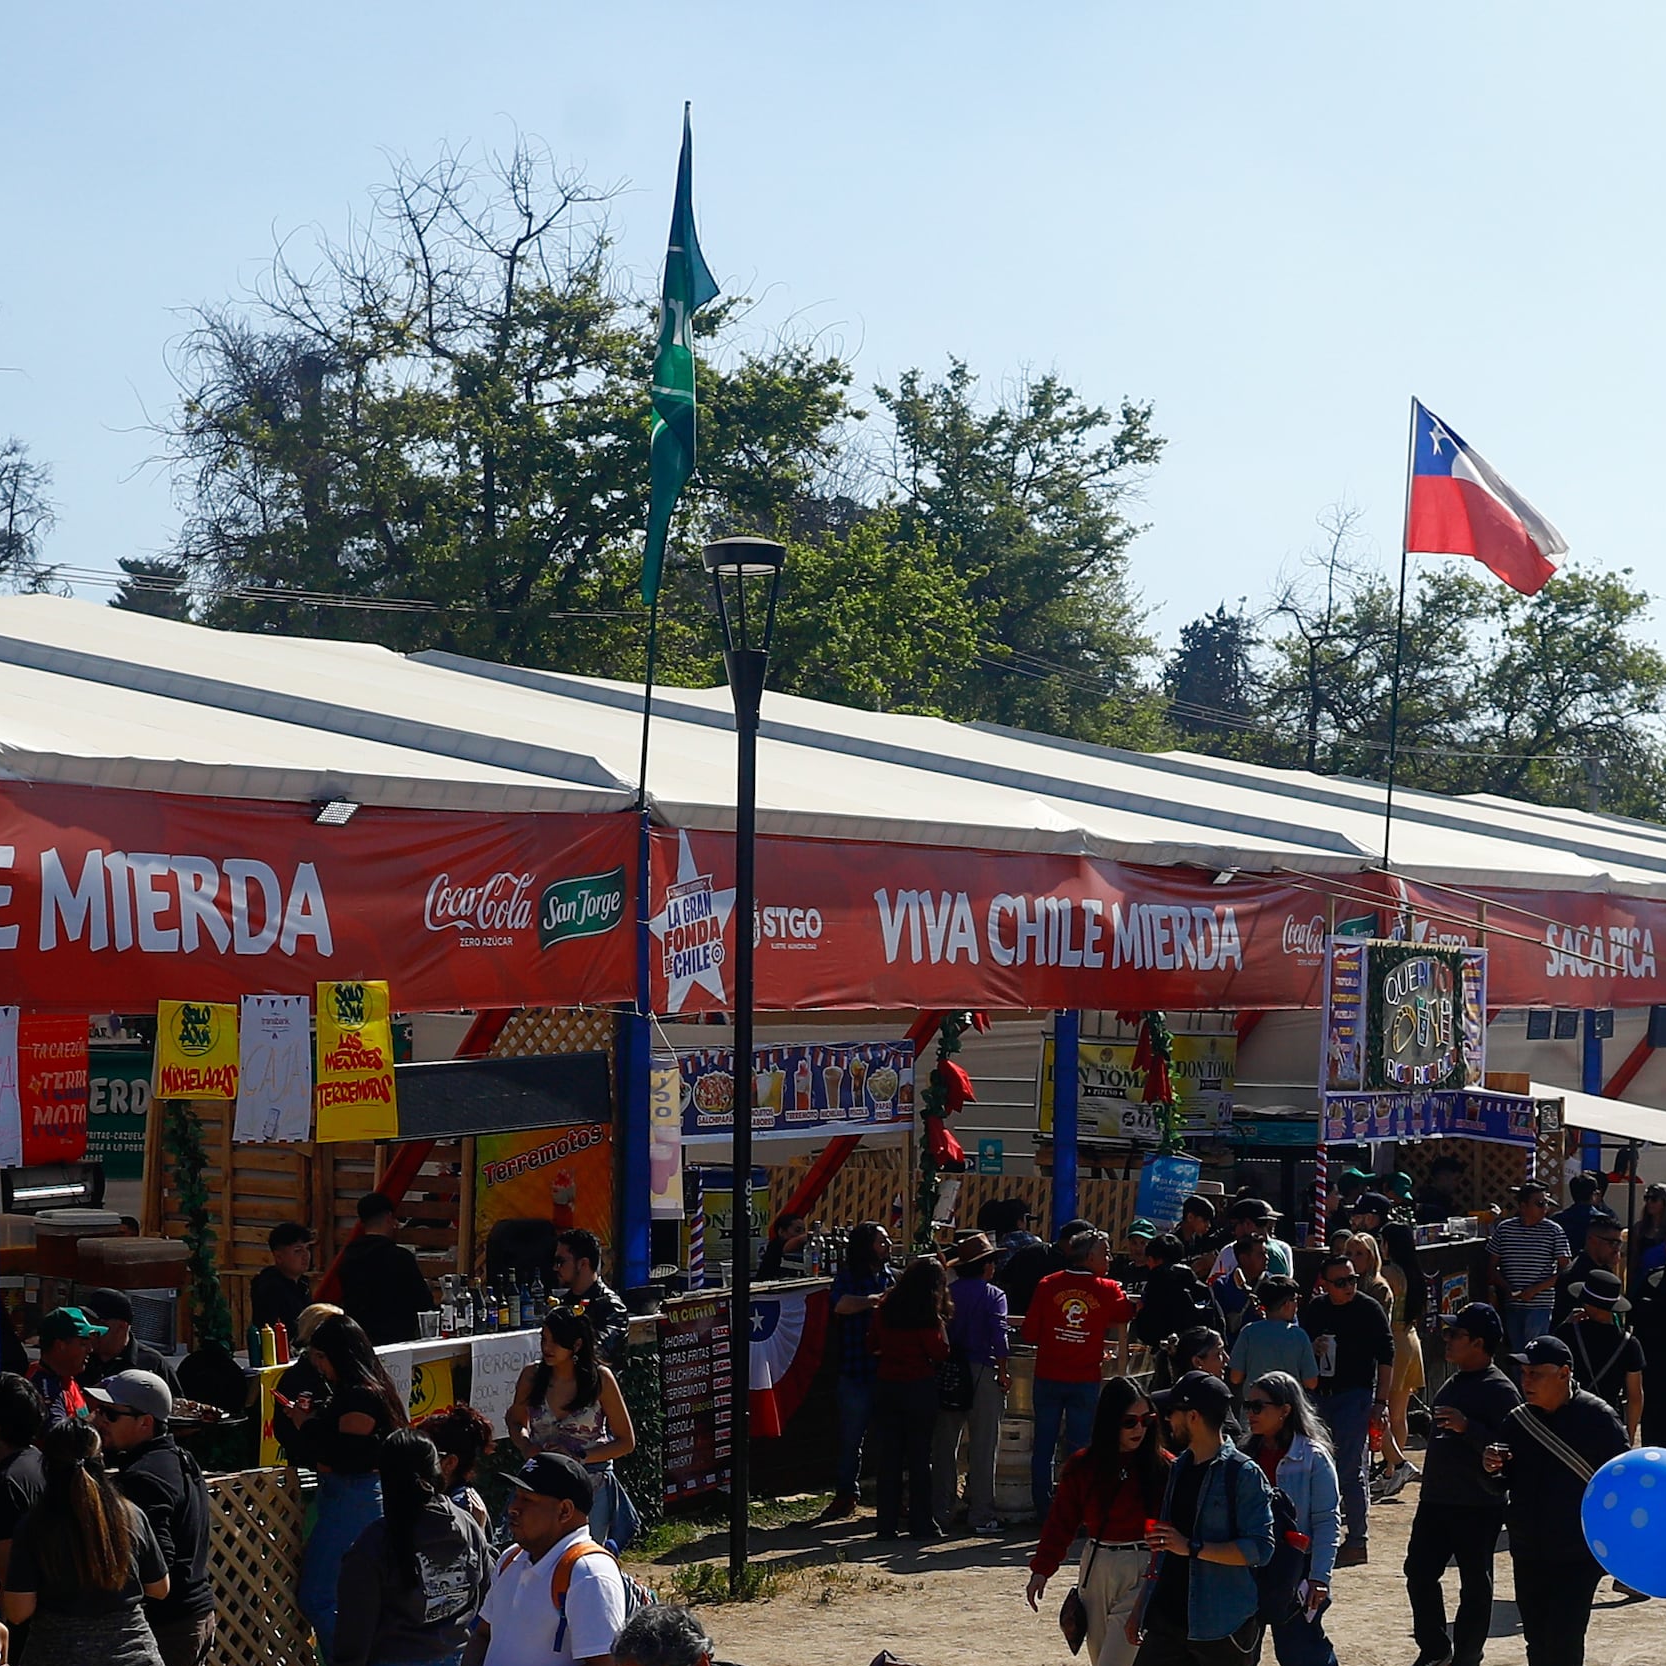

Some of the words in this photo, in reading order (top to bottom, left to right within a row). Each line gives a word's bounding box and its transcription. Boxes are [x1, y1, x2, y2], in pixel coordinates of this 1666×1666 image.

[37, 846, 334, 957] MIERDA
[424, 871, 538, 932] Coca-Cola
[542, 896, 578, 933] San
[576, 888, 622, 926] Jorge
[668, 901, 682, 929] LA
[683, 891, 712, 921] GRAN
[459, 936, 481, 947] ZERO
[482, 935, 514, 947] AZÚCAR
[663, 916, 721, 957] FONDA
[762, 905, 823, 940] STGO
[873, 887, 980, 966] VIVA
[987, 892, 1106, 969] CHILE
[1110, 901, 1245, 972] MIERDA
[1282, 914, 1326, 954] Coca-Col
[673, 944, 712, 980] CHILE
[1546, 923, 1605, 979] SACA
[1609, 926, 1656, 979] PICA
[338, 1031, 363, 1051] LOS
[161, 1063, 239, 1098] MICHELADAS
[243, 1041, 308, 1103] CAJA
[1208, 1060, 1236, 1079] TOMA
[88, 1077, 151, 1115] ERD
[316, 1074, 393, 1110] TERREMOTOS
[482, 1123, 605, 1188] Terremotos
[663, 1331, 699, 1350] CHORIPAN
[663, 1364, 711, 1384] SALCHIPAPAS
[666, 1381, 708, 1401] TERREMOTO
